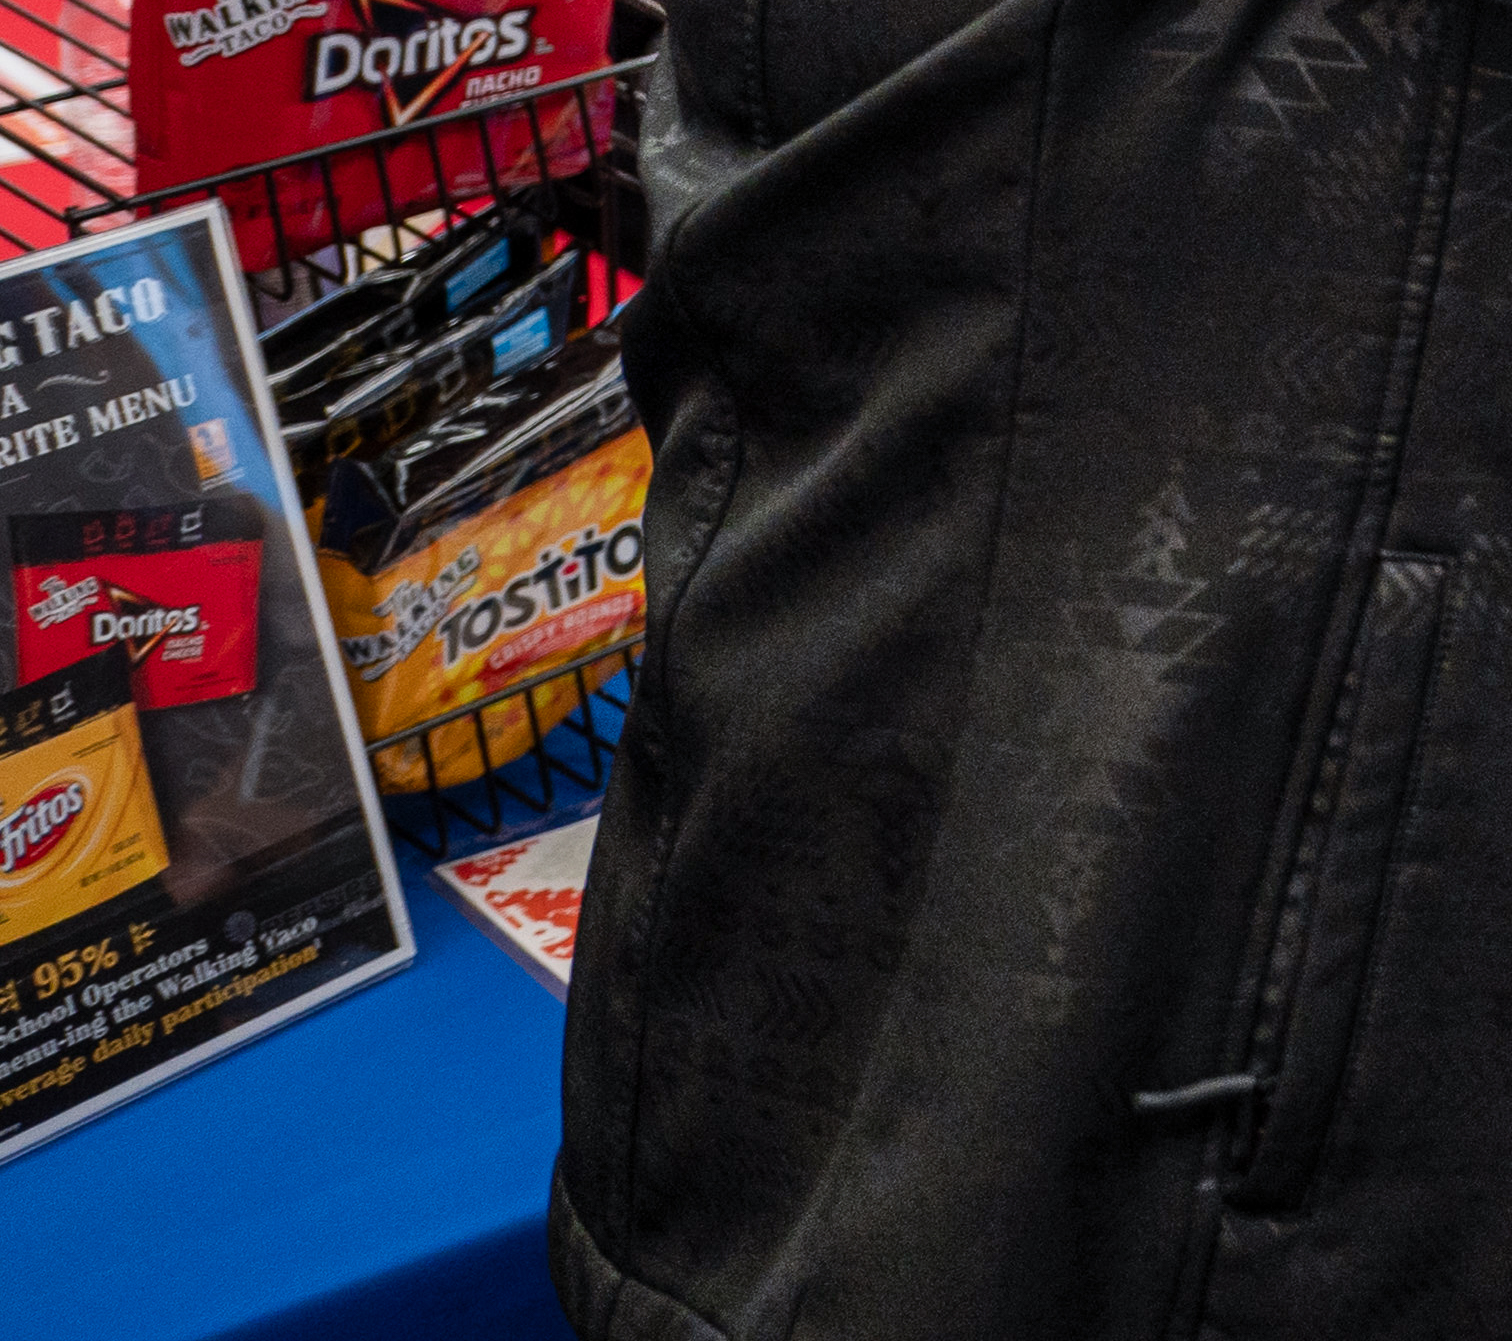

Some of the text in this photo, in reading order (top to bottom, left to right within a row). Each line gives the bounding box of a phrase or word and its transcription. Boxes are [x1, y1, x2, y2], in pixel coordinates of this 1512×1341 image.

[219, 12, 290, 54] TACO
[314, 8, 531, 97] Doritos
[465, 64, 542, 99] NACHO
[22, 277, 168, 357] TACO
[0, 373, 197, 468] RITE MENU
[92, 605, 200, 645] Doritos
[489, 624, 557, 670] CRISPY
[0, 782, 83, 874] Fritos
[32, 937, 120, 1000] 95%
[81, 938, 210, 1007] Operators
[111, 994, 153, 1024] the
[156, 939, 259, 1002] Walking
[260, 916, 319, 952] Taco
[0, 1056, 87, 1110] verage
[92, 1020, 156, 1065] daily
